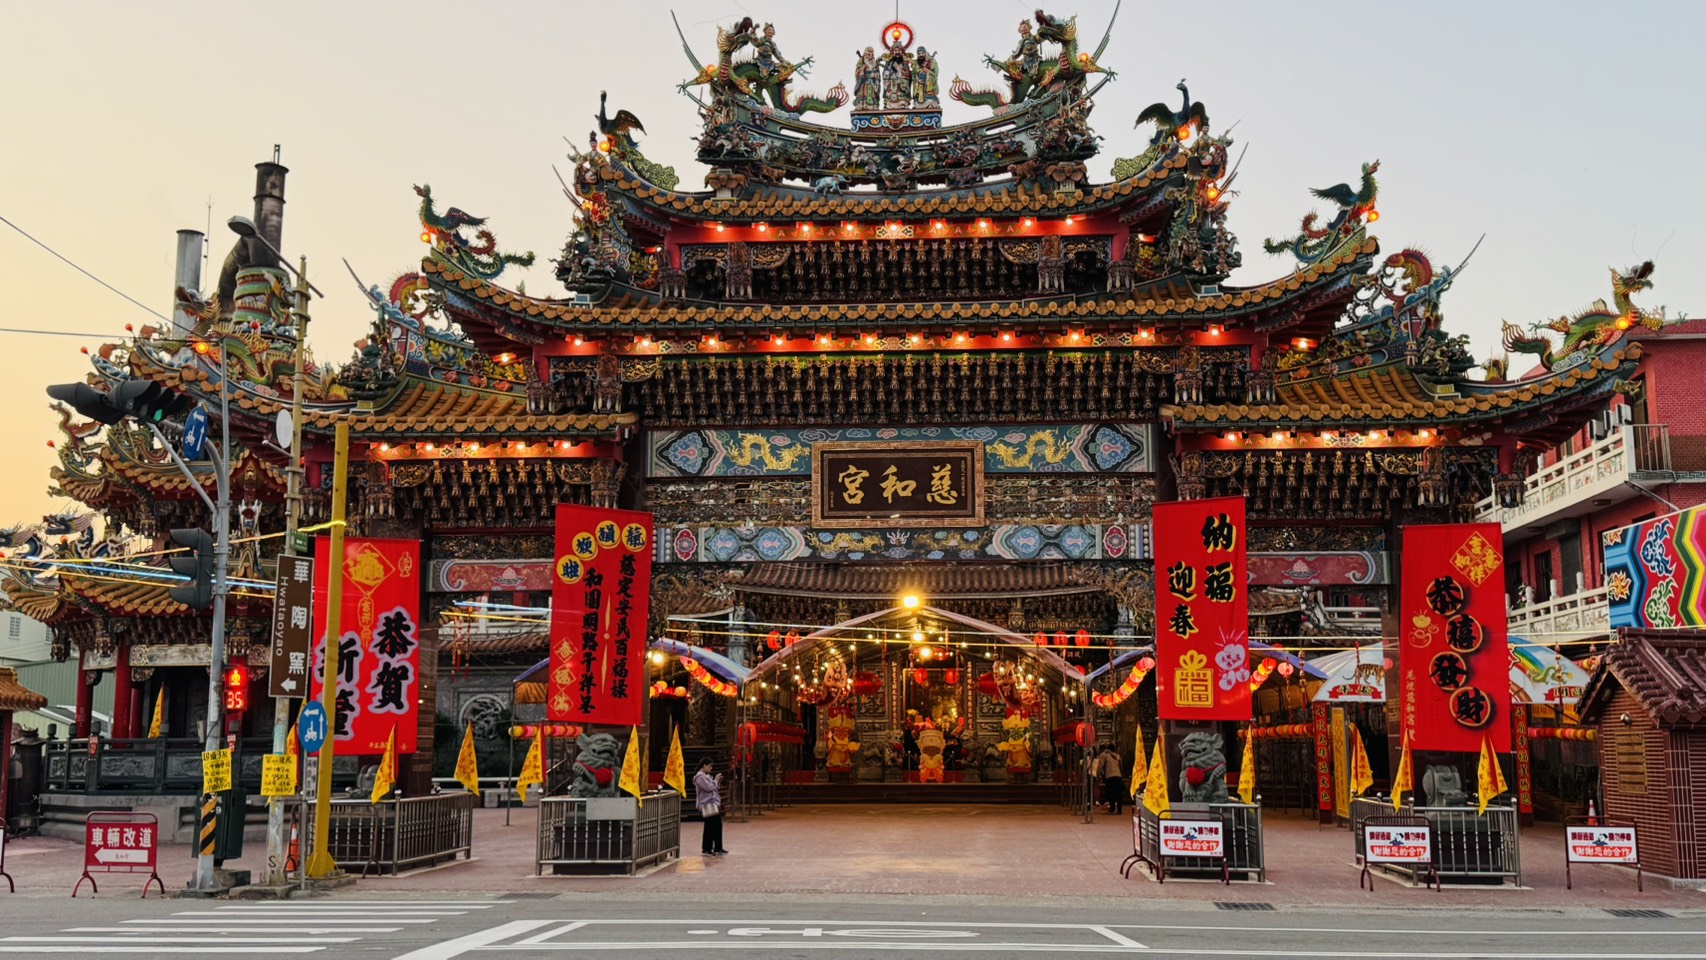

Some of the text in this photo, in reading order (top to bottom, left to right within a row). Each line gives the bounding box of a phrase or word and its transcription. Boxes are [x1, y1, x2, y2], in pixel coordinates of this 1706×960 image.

[838, 463, 958, 505] 慈和宮
[1202, 513, 1236, 602] 納福
[275, 576, 290, 657] Hwataoyao
[288, 560, 310, 675] 華陶窯
[1168, 561, 1199, 639] 迎春
[370, 609, 416, 712] 恭賀
[1179, 678, 1209, 703] 福
[227, 691, 243, 709] 35
[91, 827, 152, 848] 車輛改道
